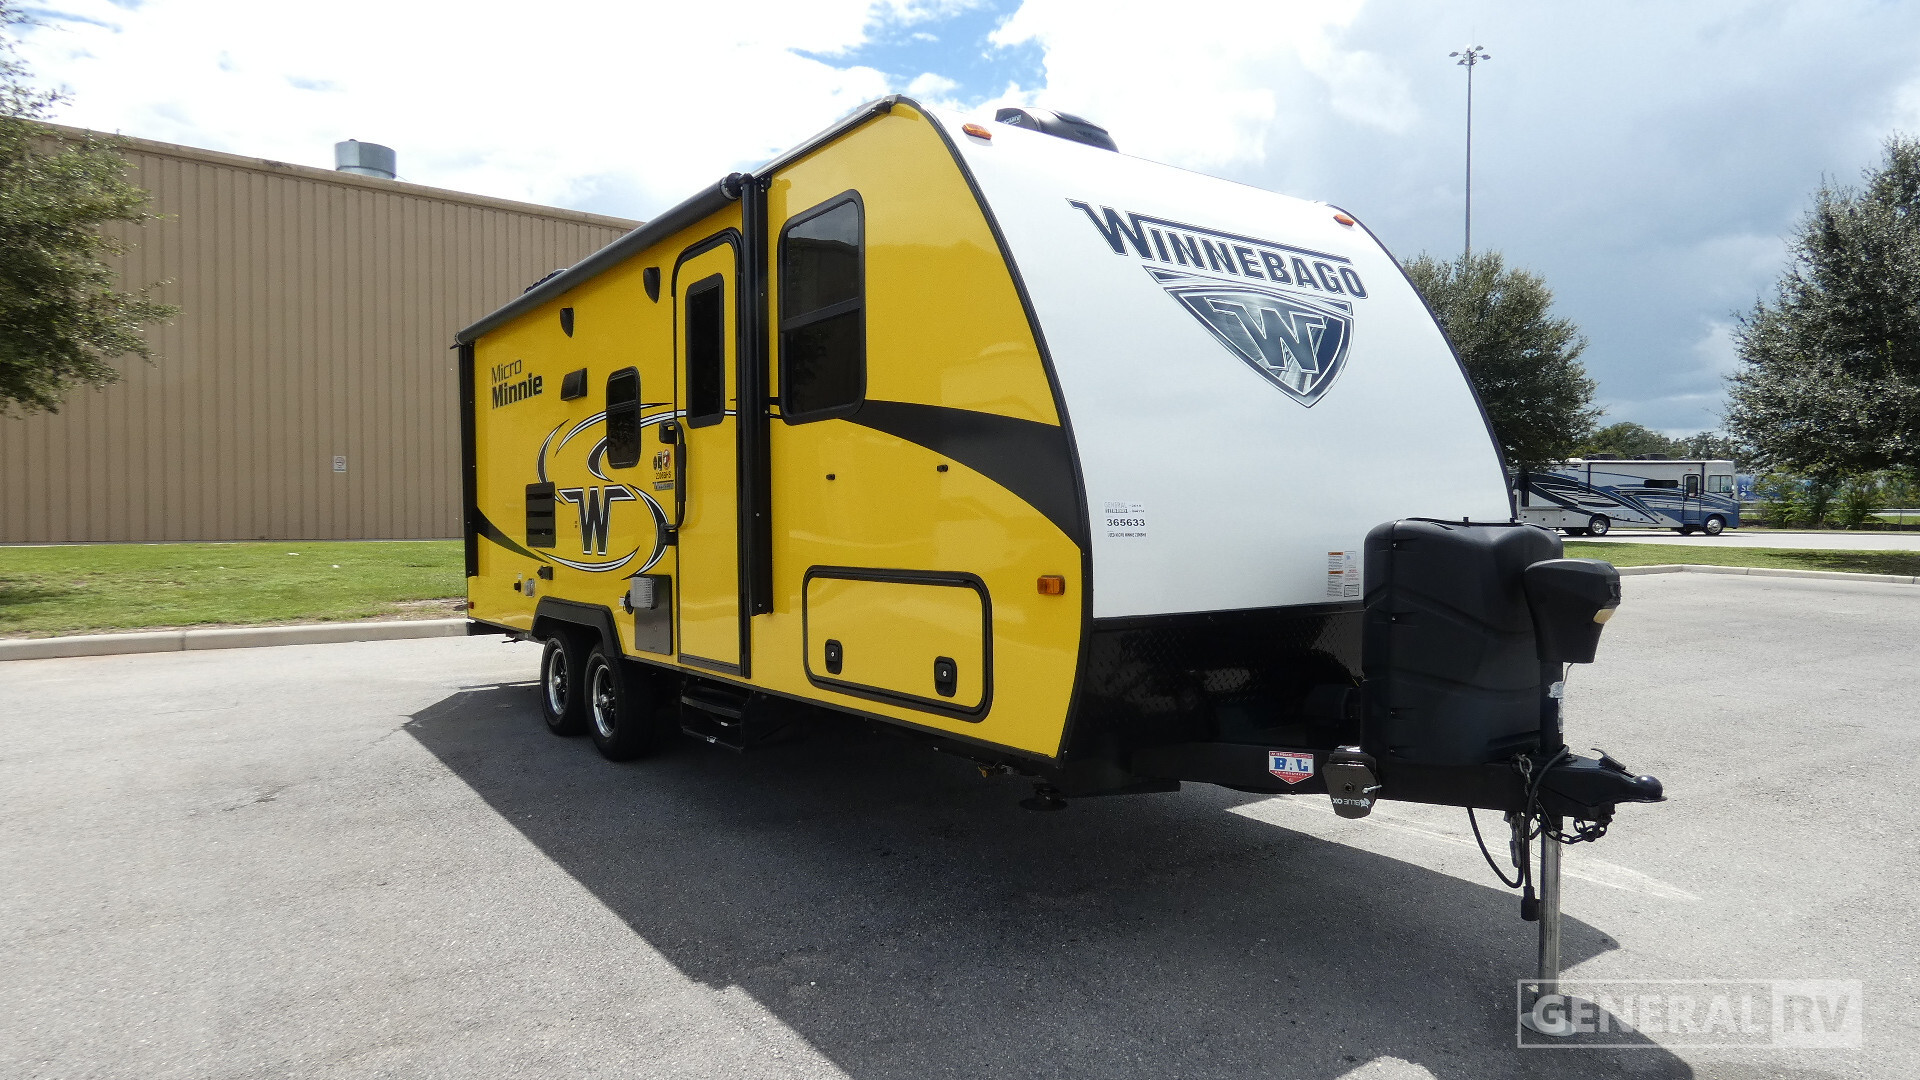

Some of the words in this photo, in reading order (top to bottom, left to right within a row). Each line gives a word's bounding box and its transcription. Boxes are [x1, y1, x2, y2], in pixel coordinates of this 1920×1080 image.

[1066, 198, 1368, 299] WINNEBAGO
[1204, 298, 1327, 374] W
[491, 359, 522, 385] Micro
[492, 372, 543, 410] Minnie
[557, 484, 637, 556] W
[1106, 518, 1145, 527] 365633
